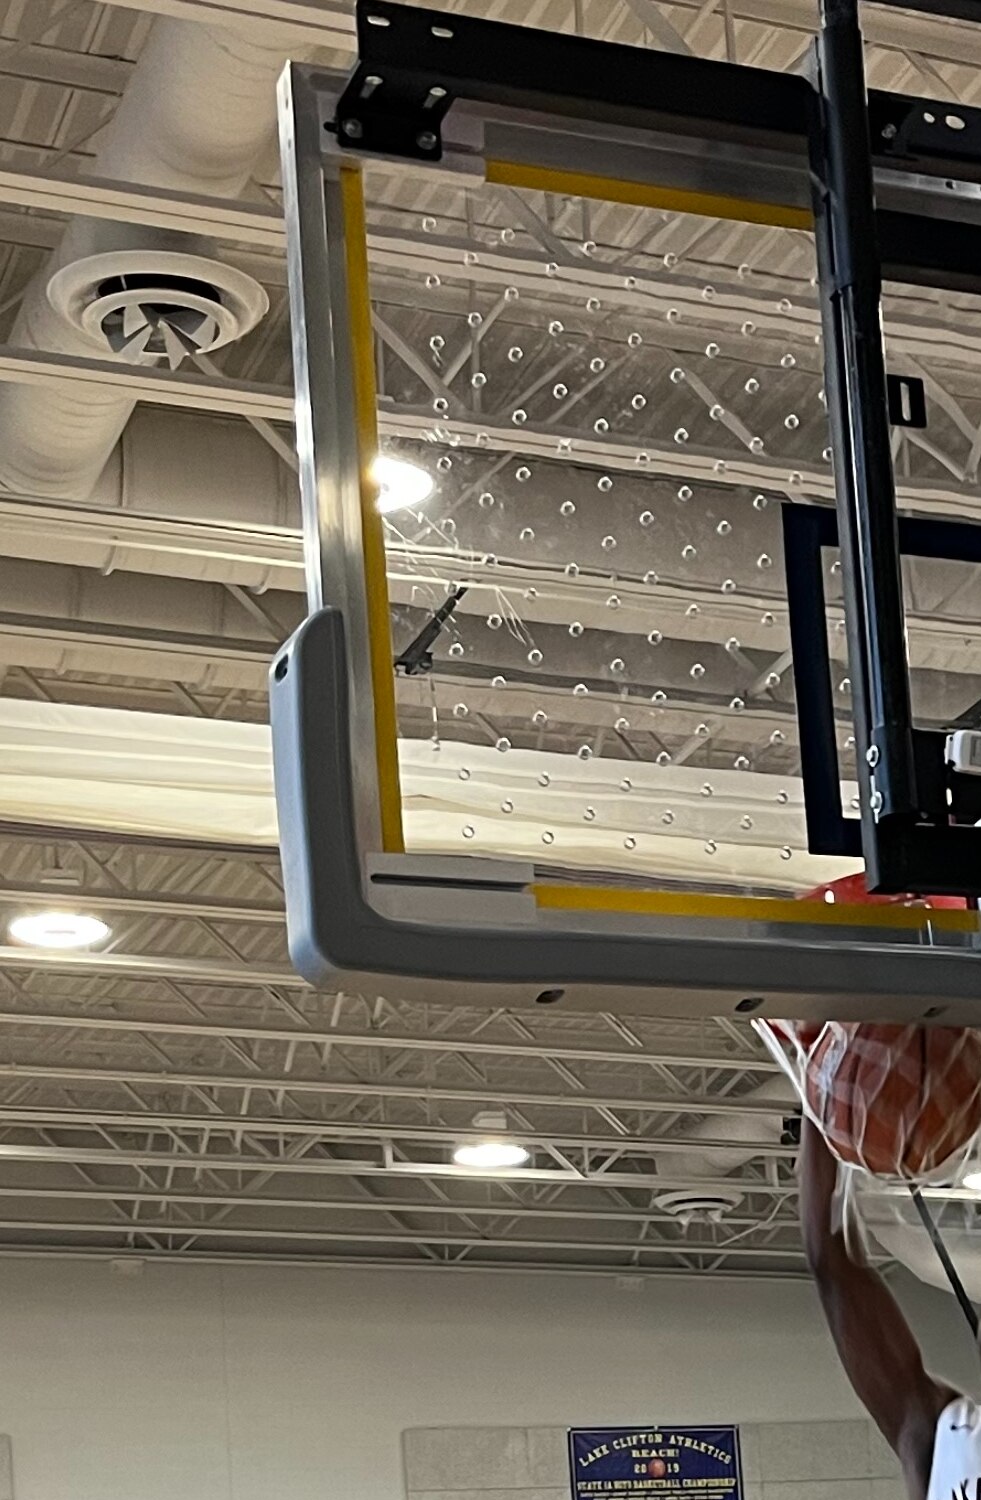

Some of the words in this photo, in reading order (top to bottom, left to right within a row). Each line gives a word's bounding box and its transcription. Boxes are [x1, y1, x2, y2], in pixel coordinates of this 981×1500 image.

[579, 1445, 609, 1467] LAKE
[612, 1434, 663, 1450] CLIFTON
[669, 1434, 732, 1465] ATHLETICS
